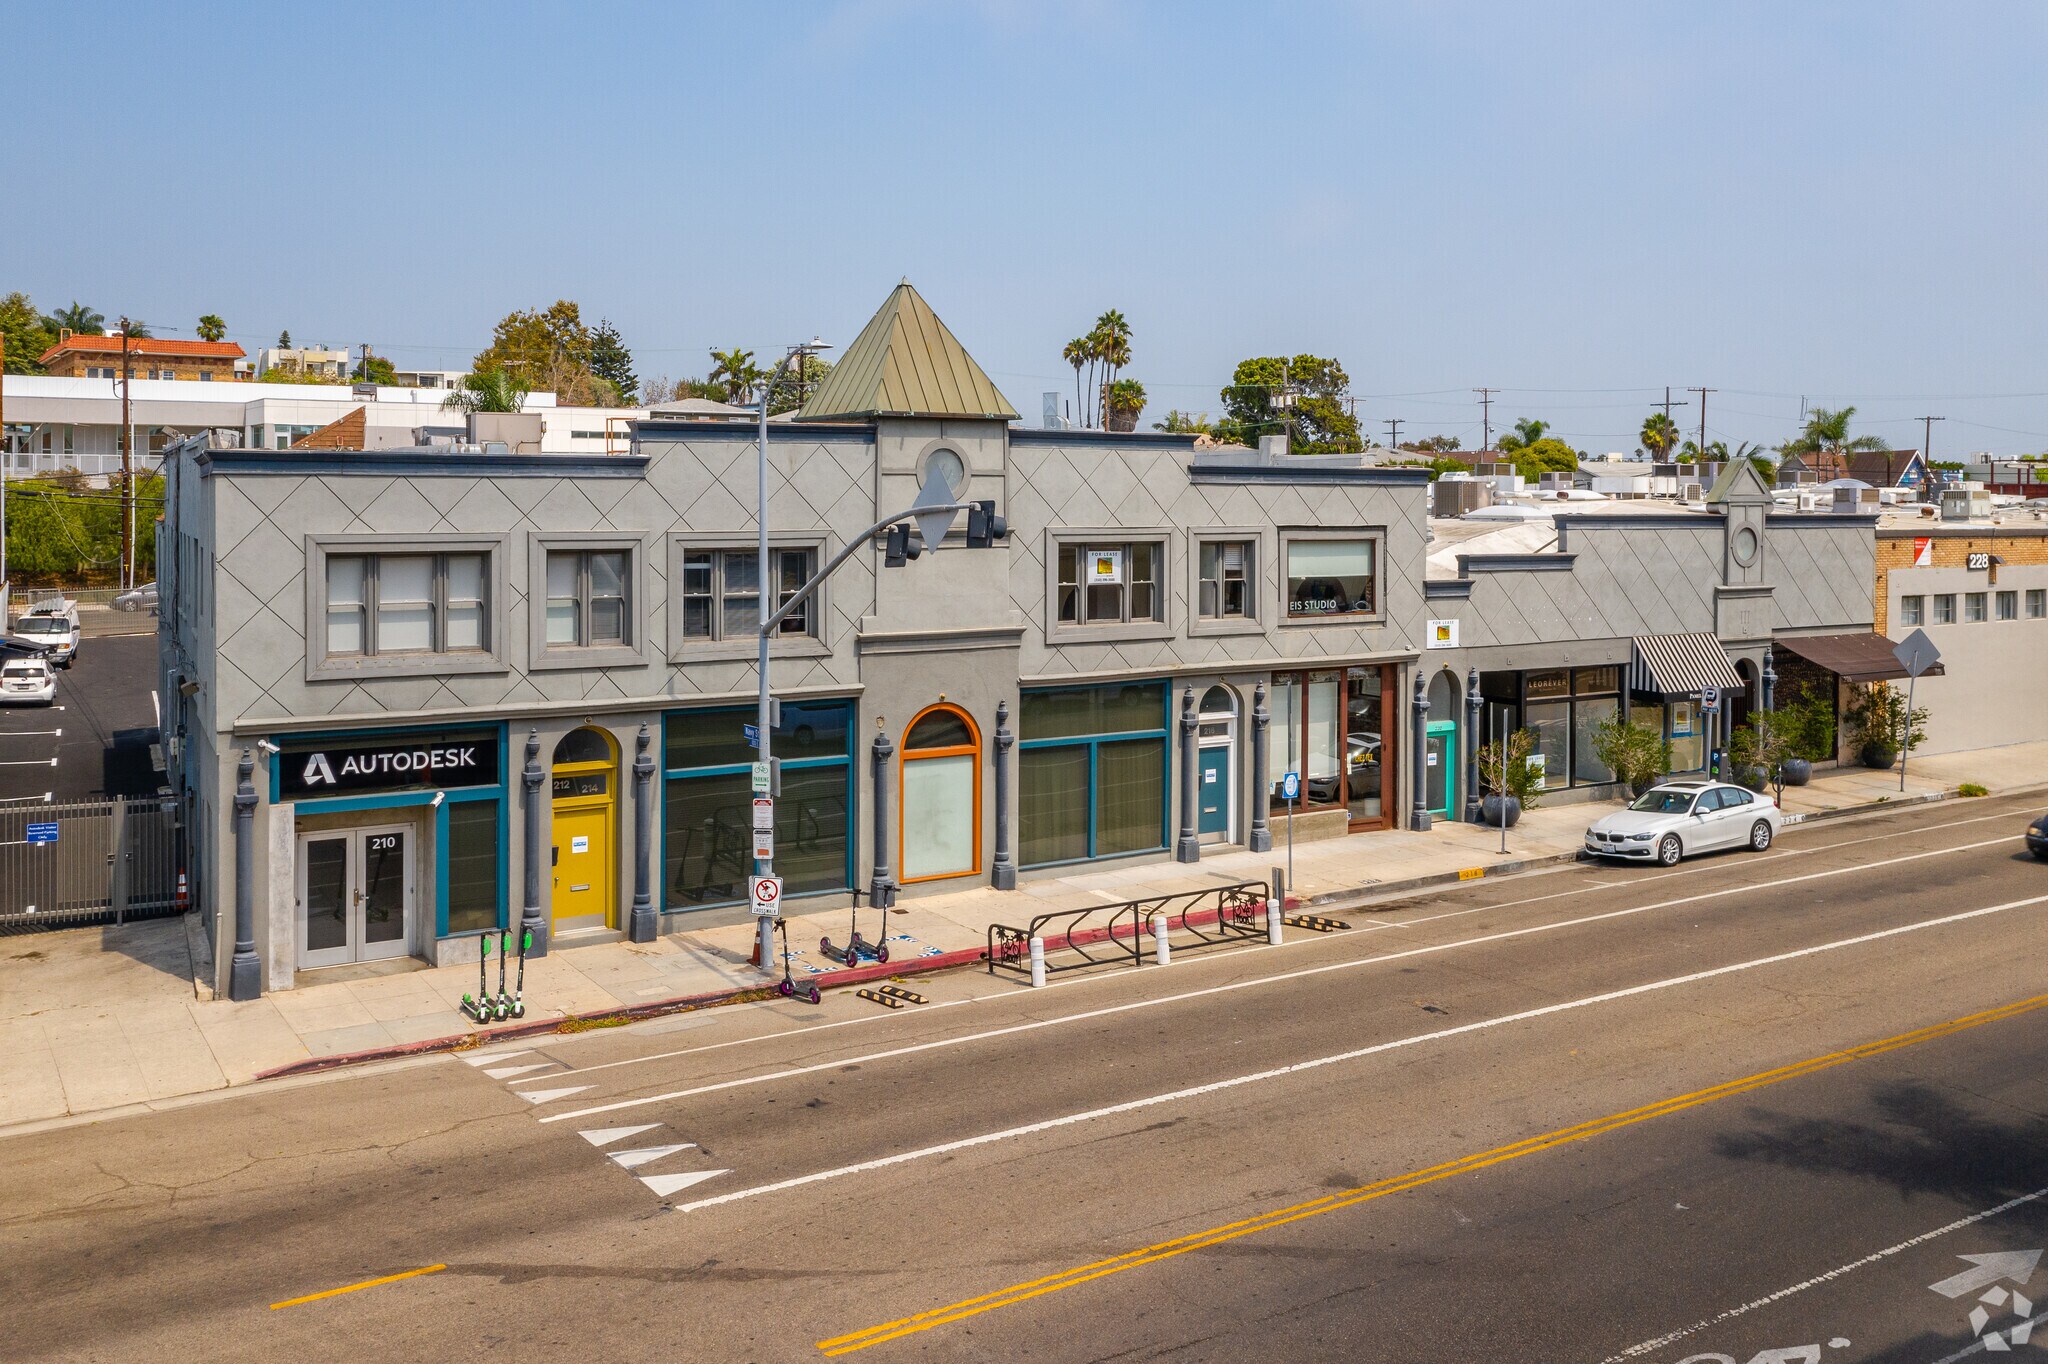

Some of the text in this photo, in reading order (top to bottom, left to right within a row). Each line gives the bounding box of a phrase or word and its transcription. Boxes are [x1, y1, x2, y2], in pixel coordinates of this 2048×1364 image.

[1969, 553, 1989, 569] 228
[1289, 599, 1337, 611] EIS STUDIO
[341, 747, 476, 776] AUTODESK
[553, 780, 599, 793] 212 214
[372, 836, 396, 850] 210
